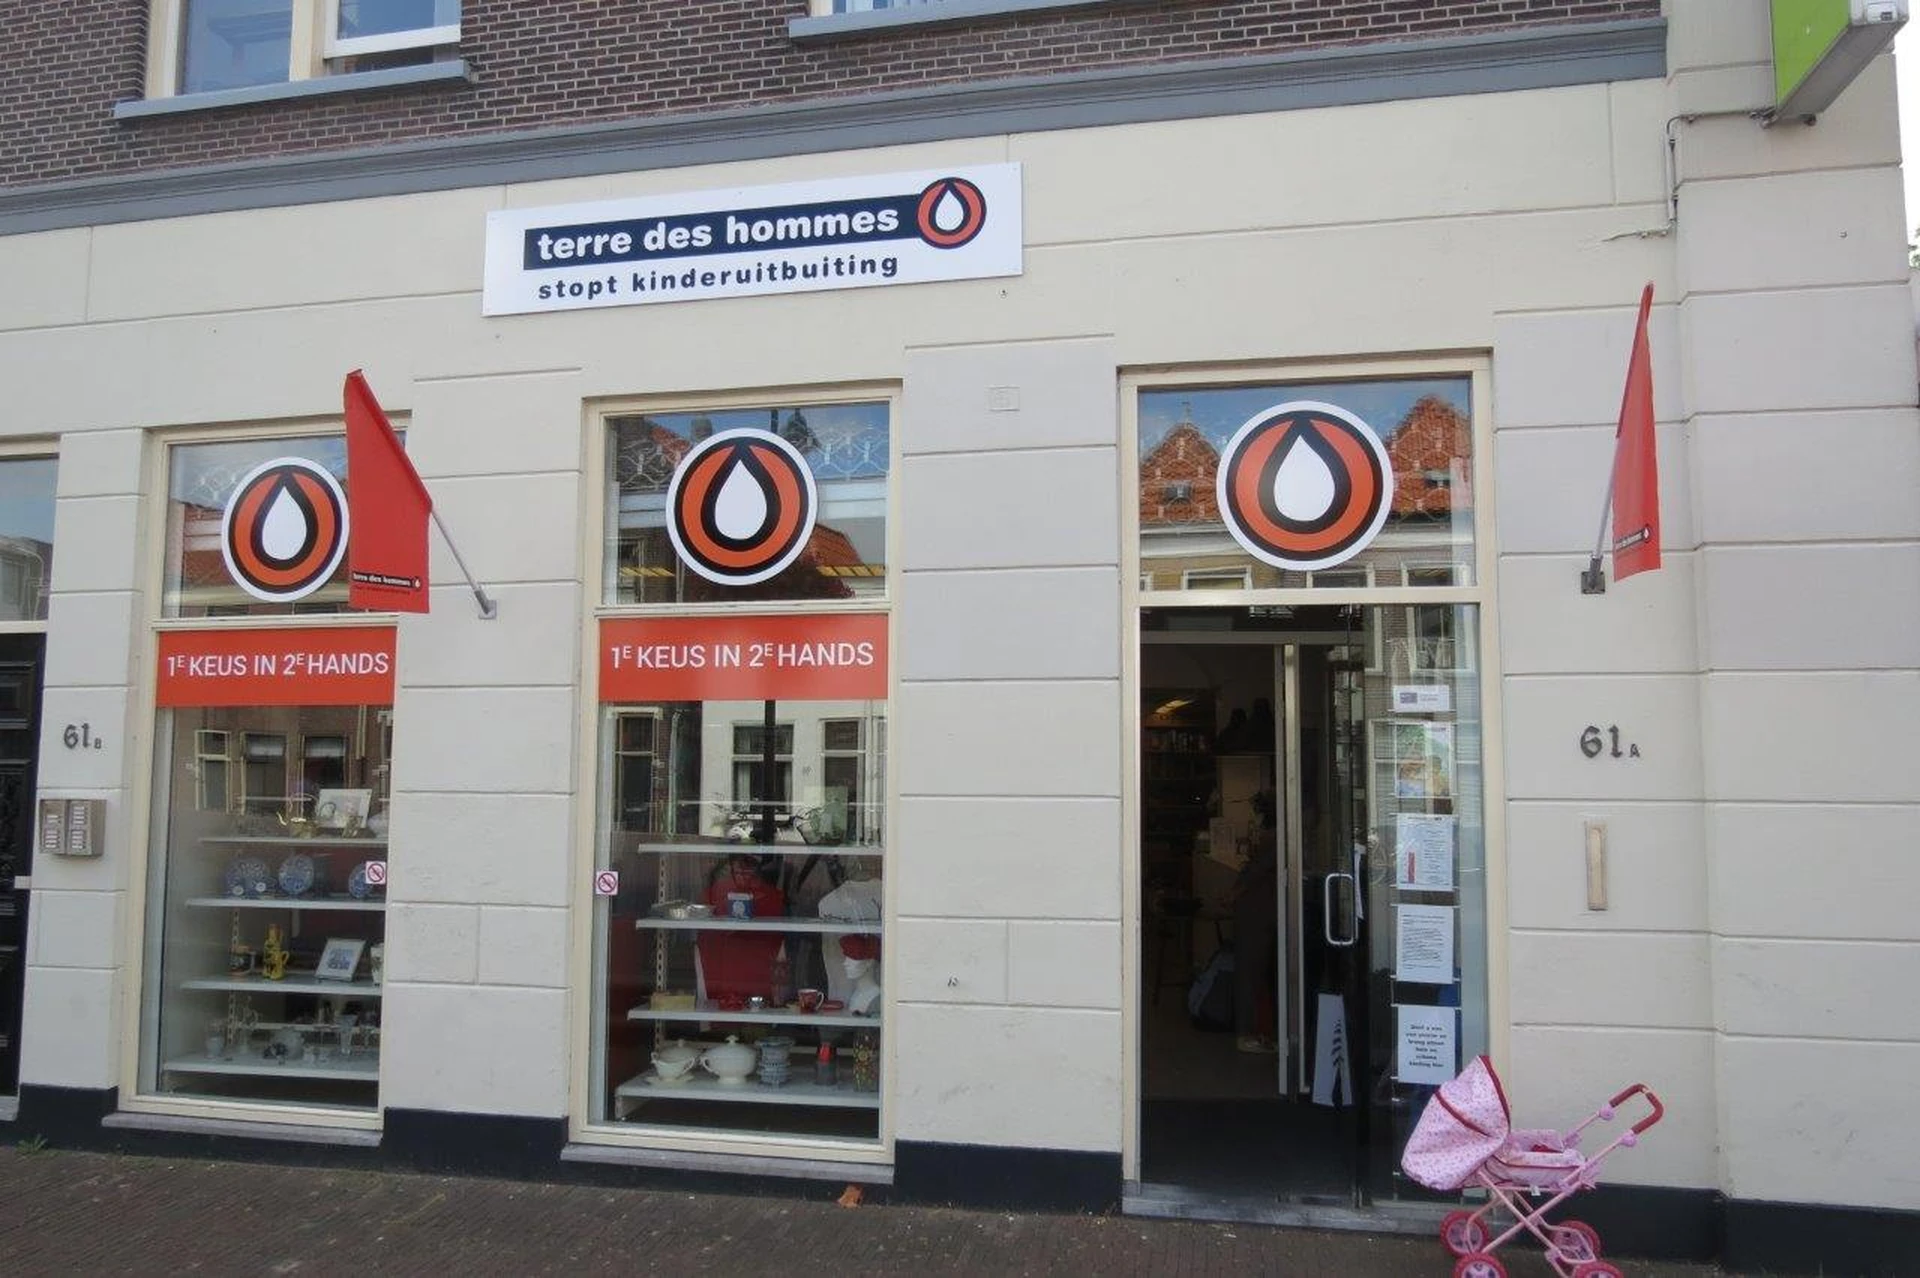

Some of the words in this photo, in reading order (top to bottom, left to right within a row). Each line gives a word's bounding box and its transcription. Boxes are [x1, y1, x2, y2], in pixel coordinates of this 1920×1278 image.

[537, 228, 631, 261] terre
[643, 221, 713, 252] des
[726, 208, 899, 244] hommes
[538, 275, 617, 300] stopt
[632, 254, 899, 293] kinderuitbuiting
[189, 656, 247, 676] KEUS
[254, 655, 276, 675] IN
[308, 652, 389, 675] HANDS
[637, 645, 705, 668] KEUS
[714, 645, 740, 667] IN
[778, 642, 874, 666] HANDS
